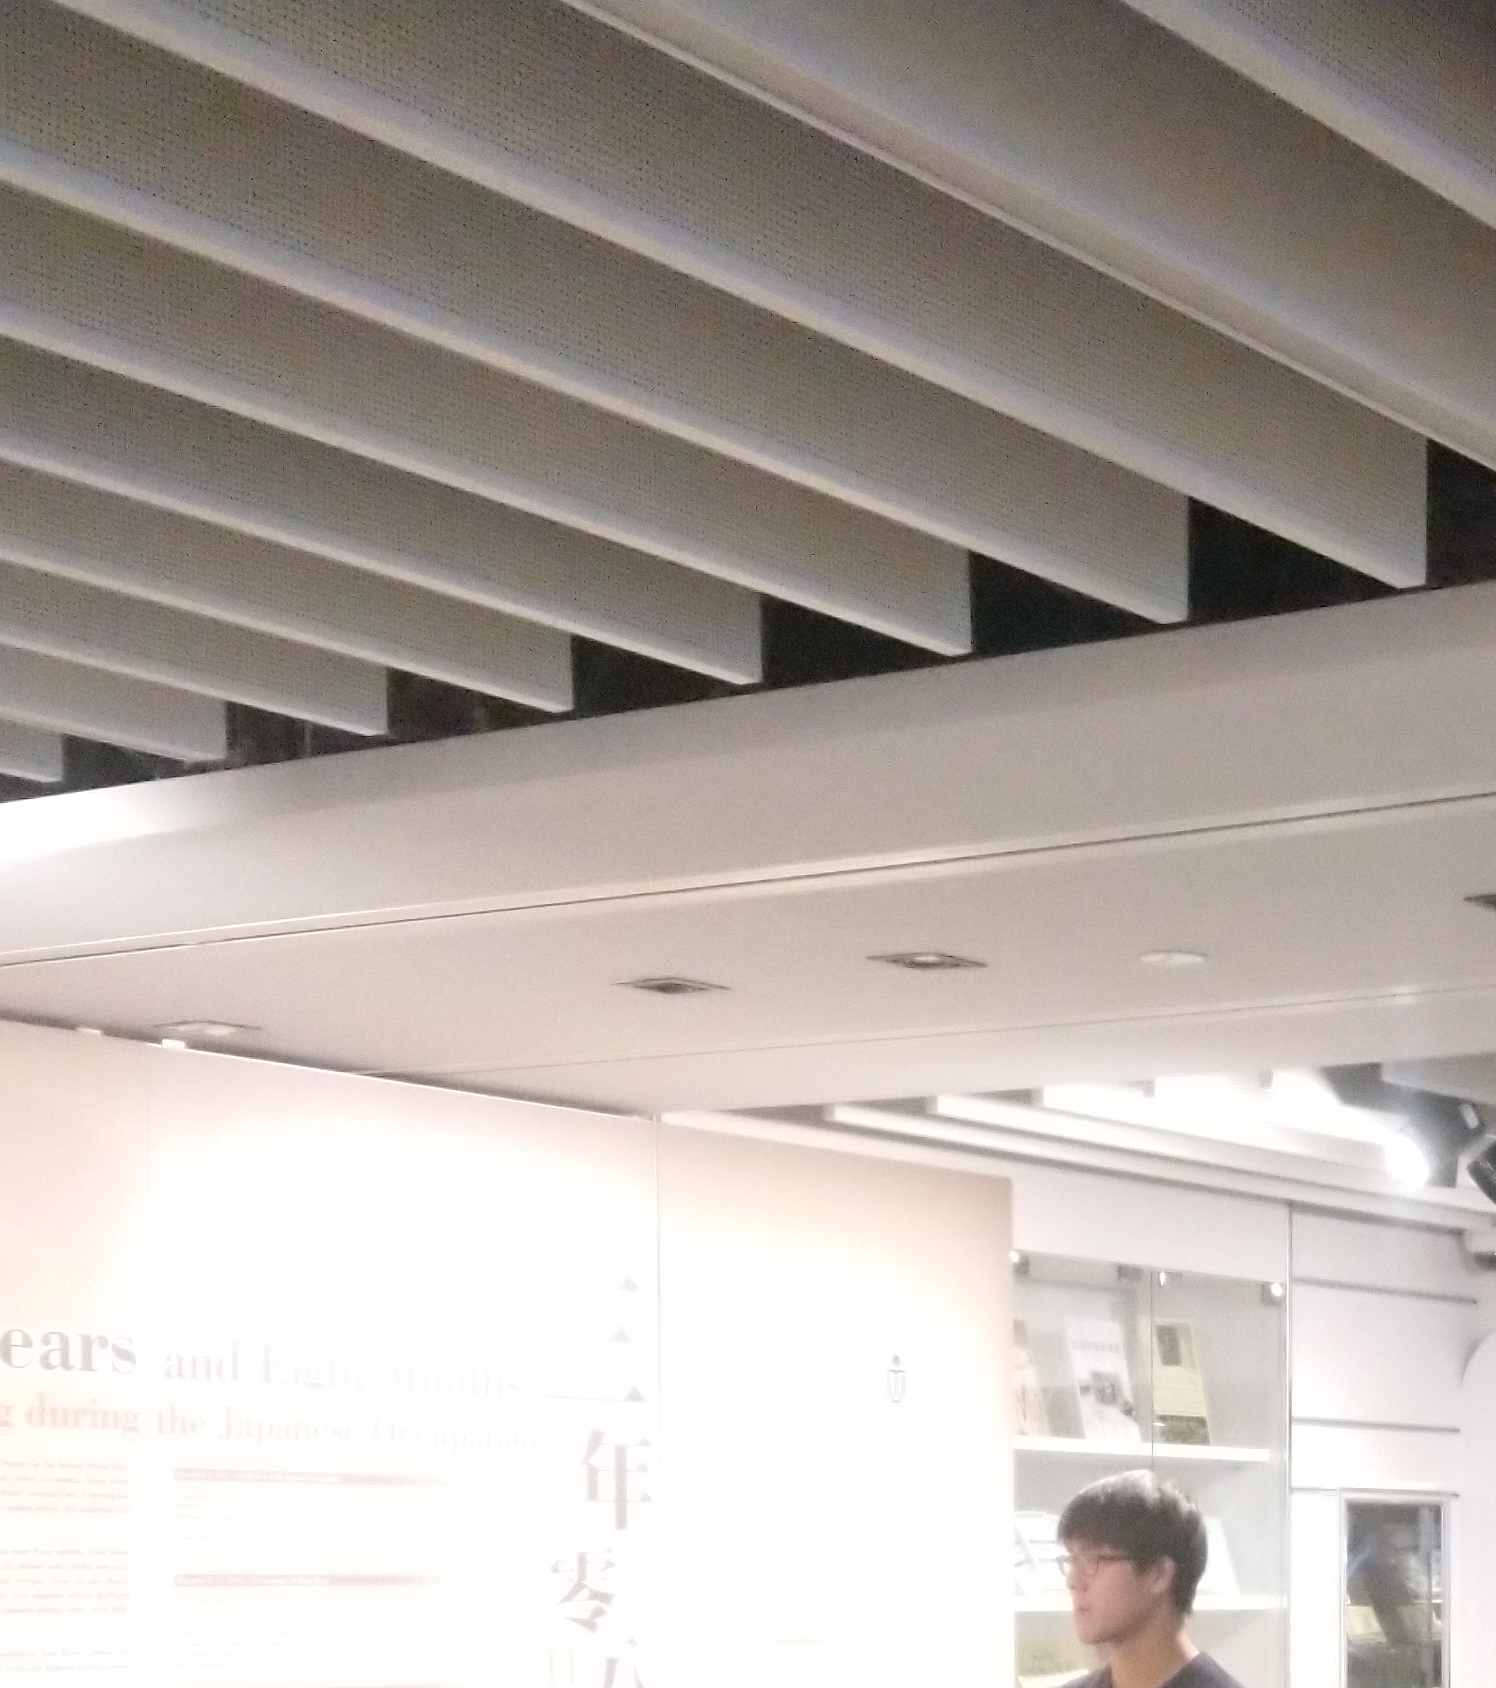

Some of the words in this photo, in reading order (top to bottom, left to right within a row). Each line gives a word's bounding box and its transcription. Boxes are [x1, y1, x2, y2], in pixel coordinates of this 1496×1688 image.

[165, 1338, 238, 1385] and
[262, 1344, 366, 1394] Eight
[26, 1392, 141, 1439] during
[157, 1404, 206, 1440] the
[219, 1406, 357, 1449] Japanese
[372, 1417, 538, 1456] Occupation
